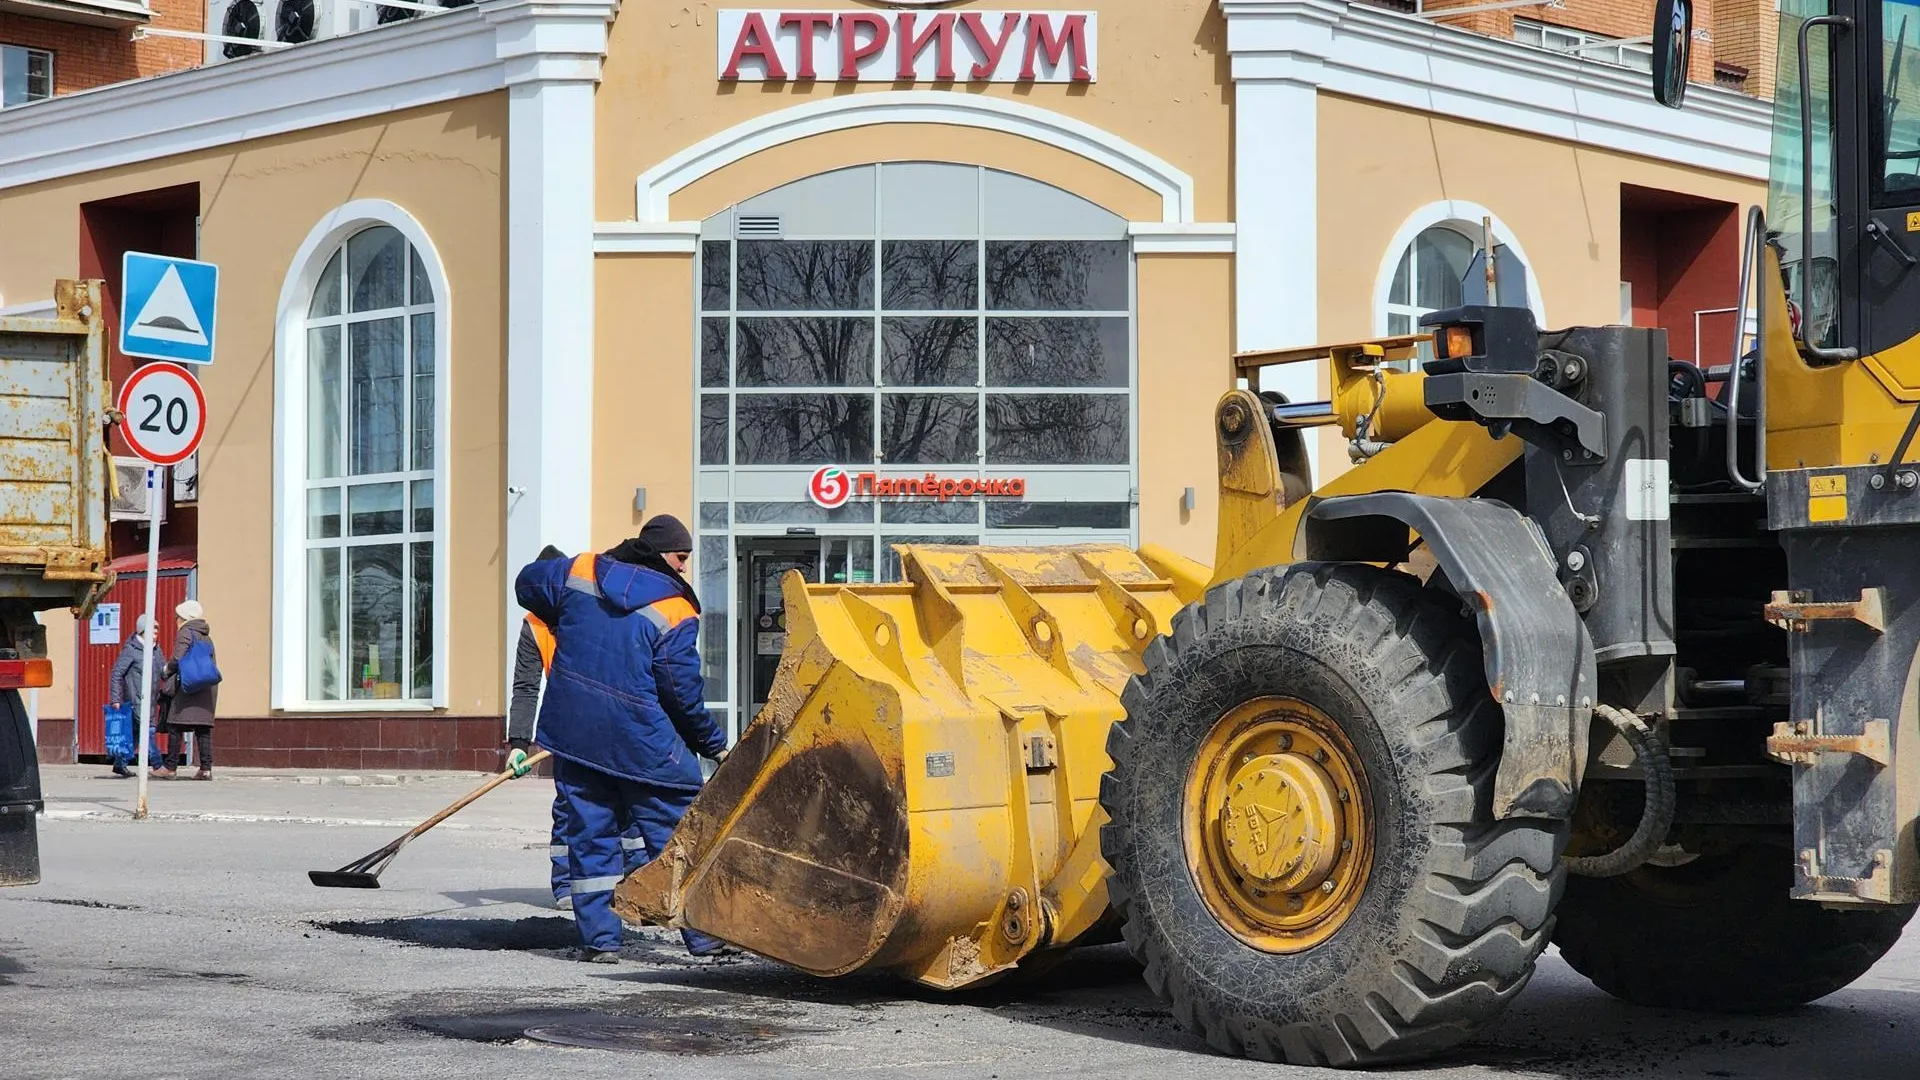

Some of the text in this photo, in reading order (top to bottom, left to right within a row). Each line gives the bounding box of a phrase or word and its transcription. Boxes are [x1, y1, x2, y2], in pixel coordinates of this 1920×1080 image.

[722, 12, 1091, 79] АТРИУМ
[139, 394, 188, 435] 20
[857, 473, 1025, 503] Пятёрочка
